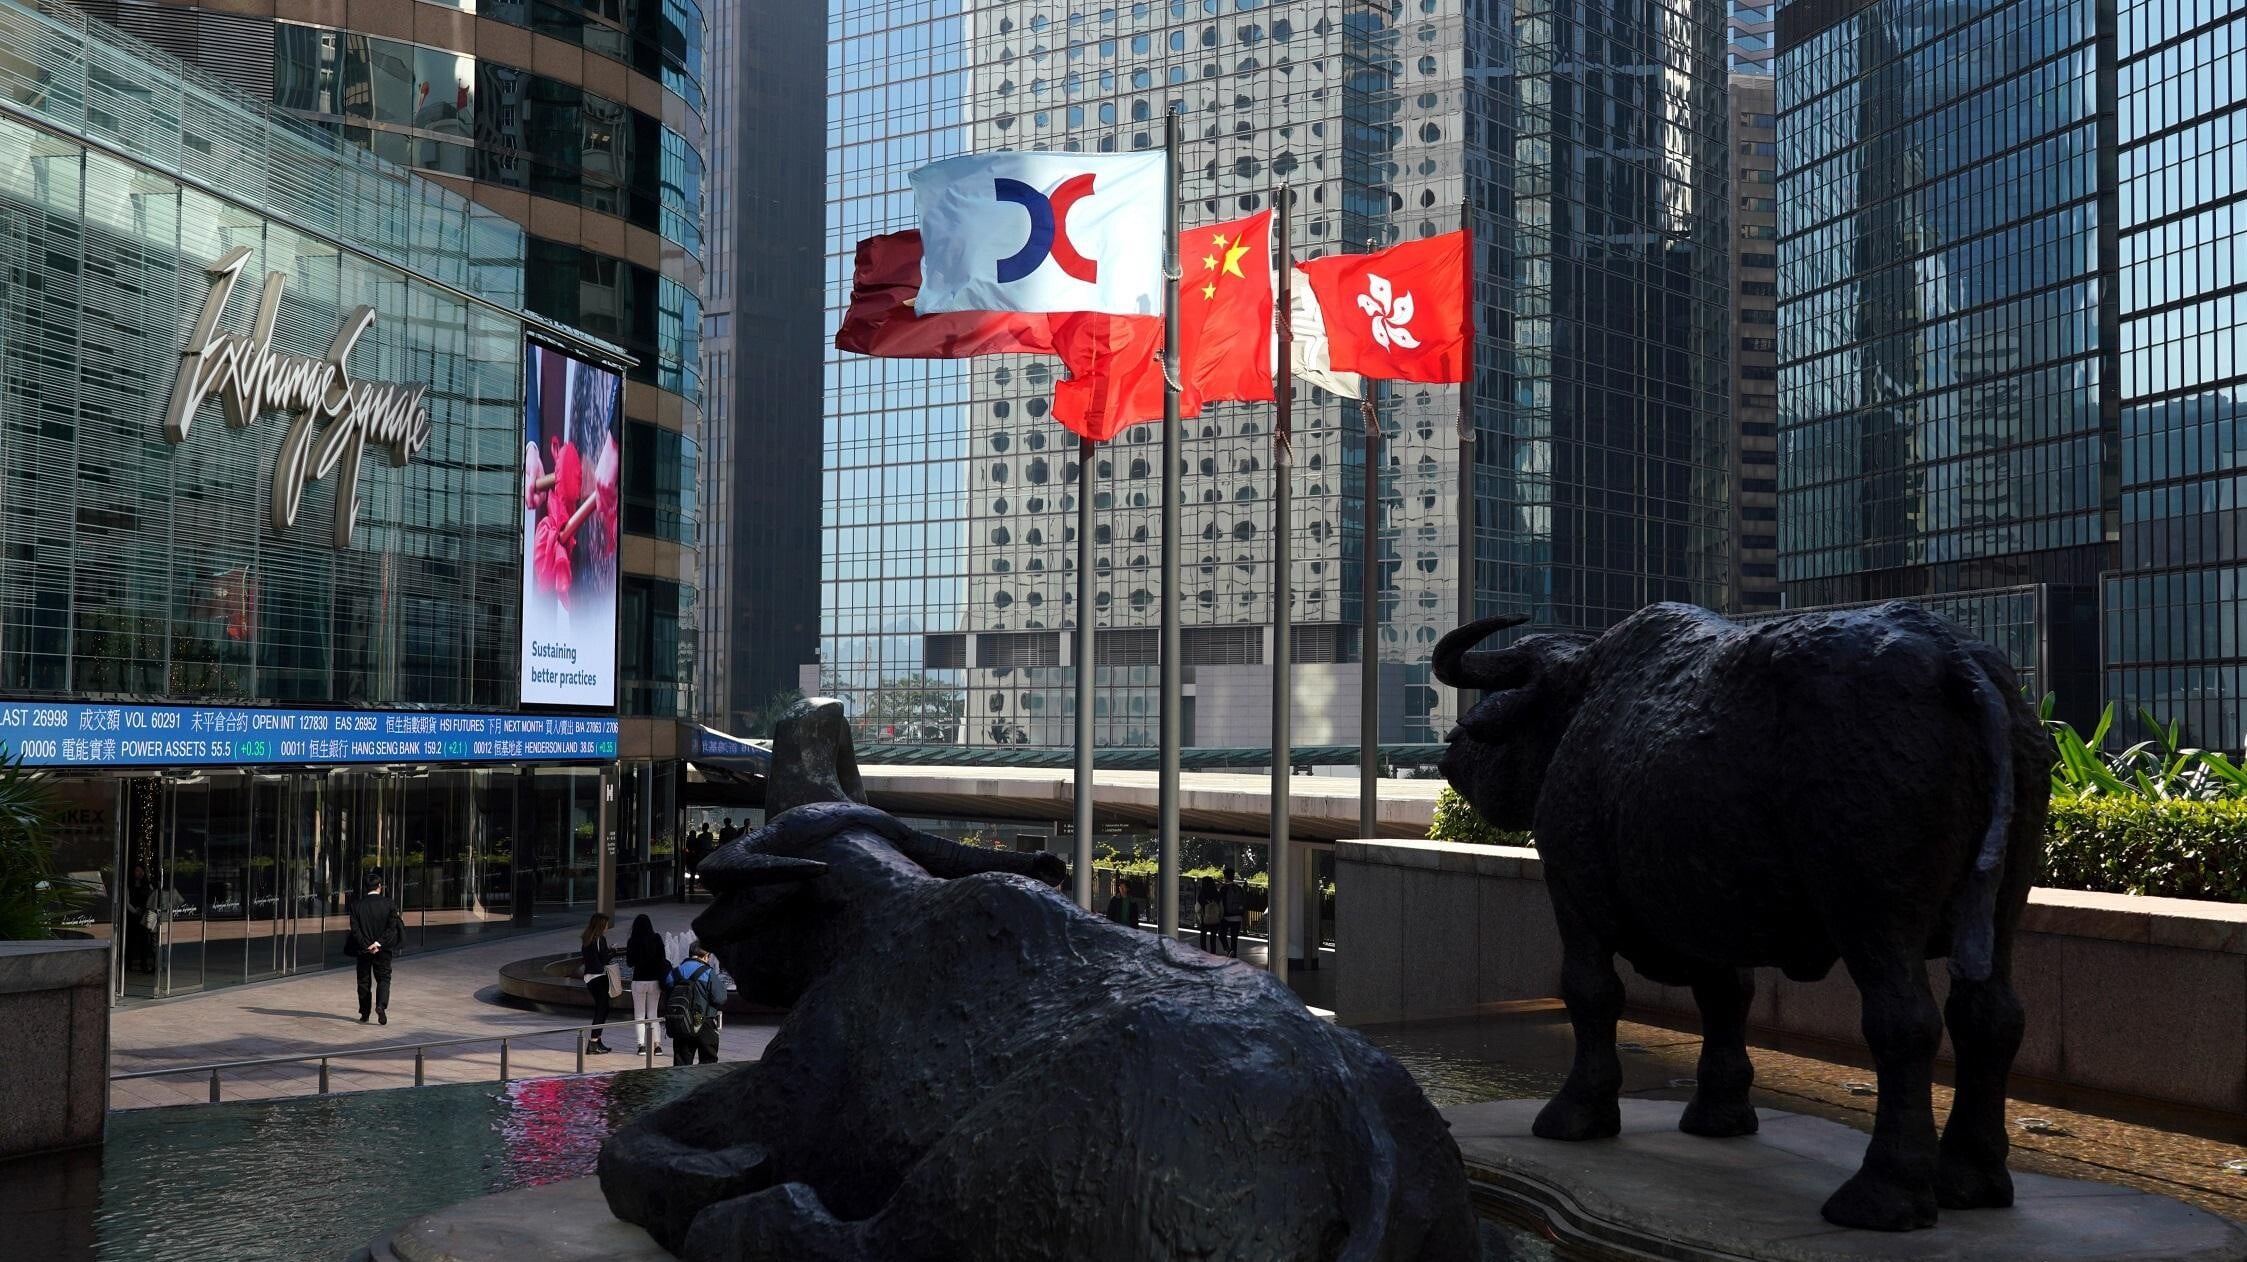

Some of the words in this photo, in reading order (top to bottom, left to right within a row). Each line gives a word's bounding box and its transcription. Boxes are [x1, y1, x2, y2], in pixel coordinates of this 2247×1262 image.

[306, 304, 431, 549] Square
[532, 640, 577, 664] Sustaining
[531, 666, 558, 684] better
[560, 670, 597, 688] practices
[33, 710, 68, 726] 26998
[79, 708, 120, 730] 成交額
[125, 712, 147, 728] VOL
[152, 712, 180, 728] 60291
[191, 711, 248, 732] 未平倉合約
[252, 714, 278, 729] OPEN
[280, 716, 295, 729] INT
[300, 716, 328, 730] 127830
[336, 716, 352, 730] EAS
[354, 717, 377, 730] 26952
[386, 716, 437, 734] 恒生指數期貨
[440, 718, 452, 732] HSI
[453, 719, 485, 732] FUTURES
[488, 718, 501, 735] 下月
[504, 720, 520, 732] NEXT
[522, 720, 543, 732] MONTH
[586, 722, 601, 733] 27063
[21, 740, 56, 758] 00006
[62, 738, 116, 760] 電能實業
[121, 741, 162, 757] POWER
[164, 741, 206, 756] ASSETS
[211, 741, 231, 756] 55.5
[281, 741, 305, 755] 00011
[309, 739, 348, 758] 恒生銀行
[352, 742, 374, 755] HANG
[376, 741, 398, 755] SENG
[400, 741, 420, 754] BANK
[424, 741, 442, 754] 159.2
[474, 741, 492, 754] 00012
[494, 739, 522, 756] 恒基地產
[524, 741, 561, 754] HENDERSON
[562, 742, 577, 753] LAND
[606, 784, 614, 802] H
